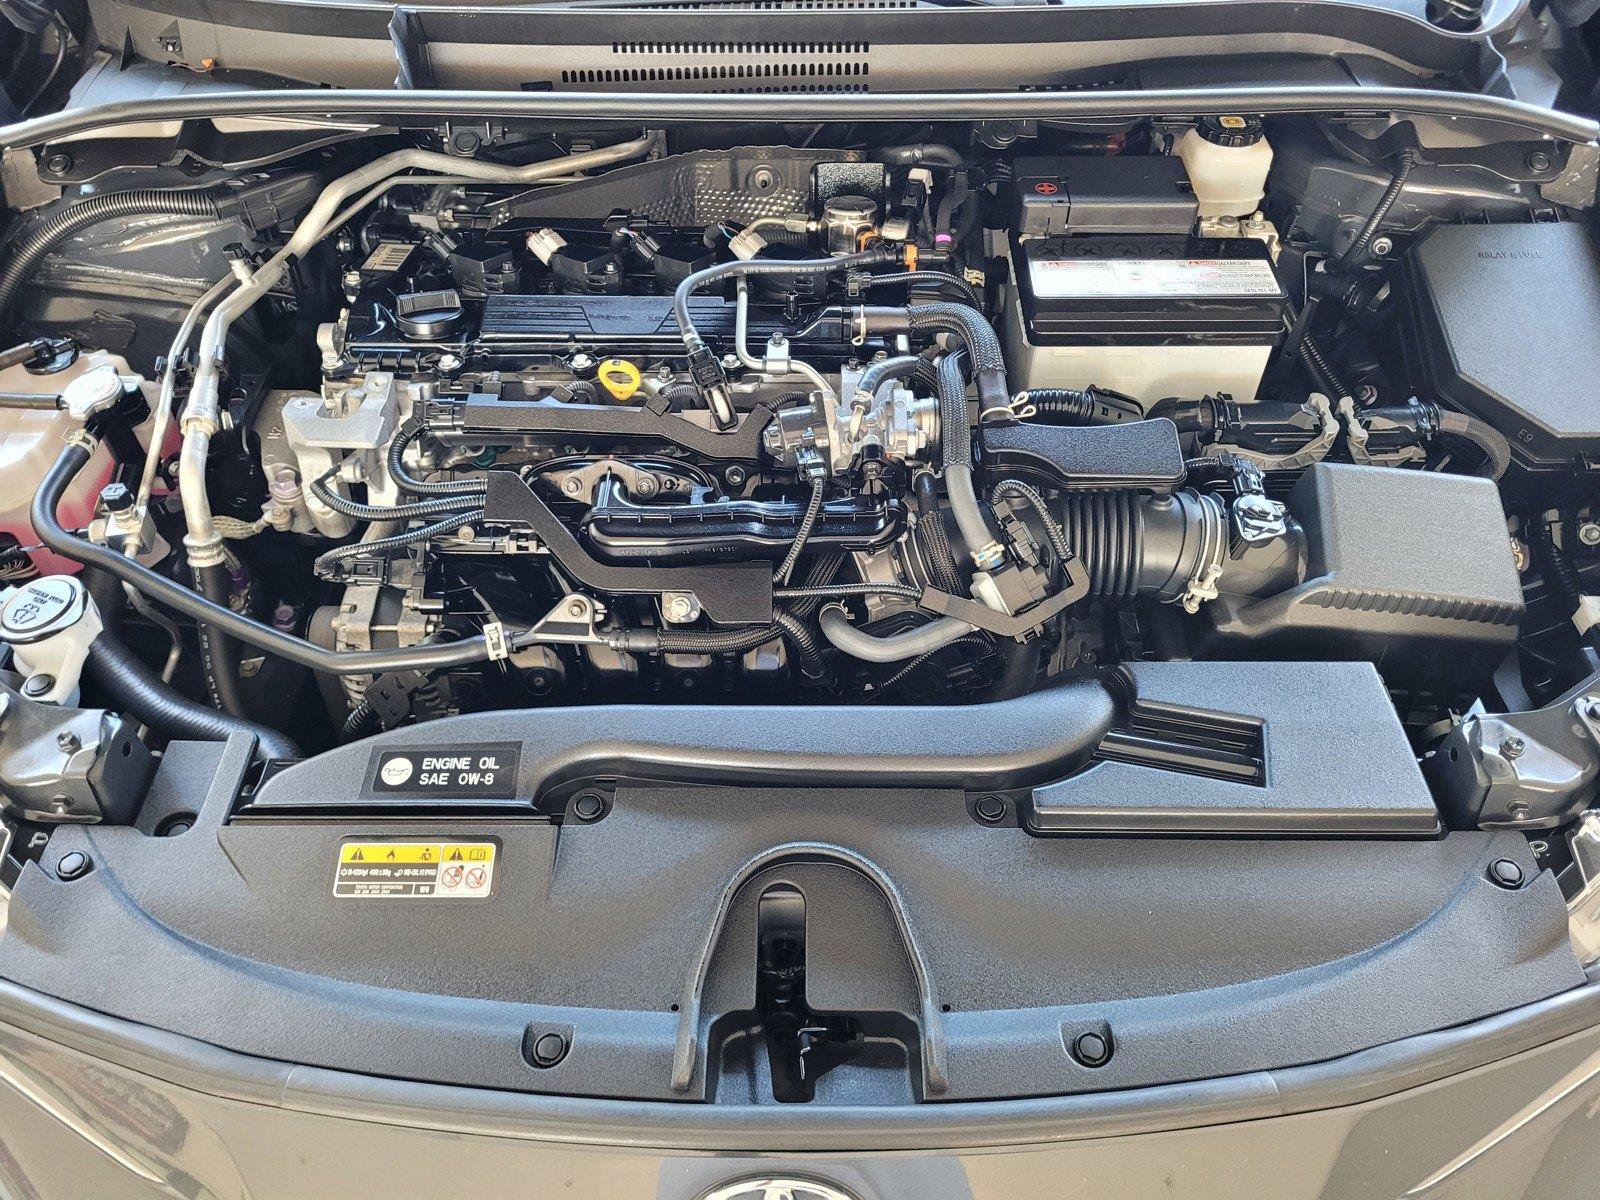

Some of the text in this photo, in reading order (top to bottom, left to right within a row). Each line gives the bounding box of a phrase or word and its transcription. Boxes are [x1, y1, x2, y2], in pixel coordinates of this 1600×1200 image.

[1517, 428, 1534, 443] E9
[422, 757, 500, 770] ENGINE OIL
[418, 773, 450, 786] SAE
